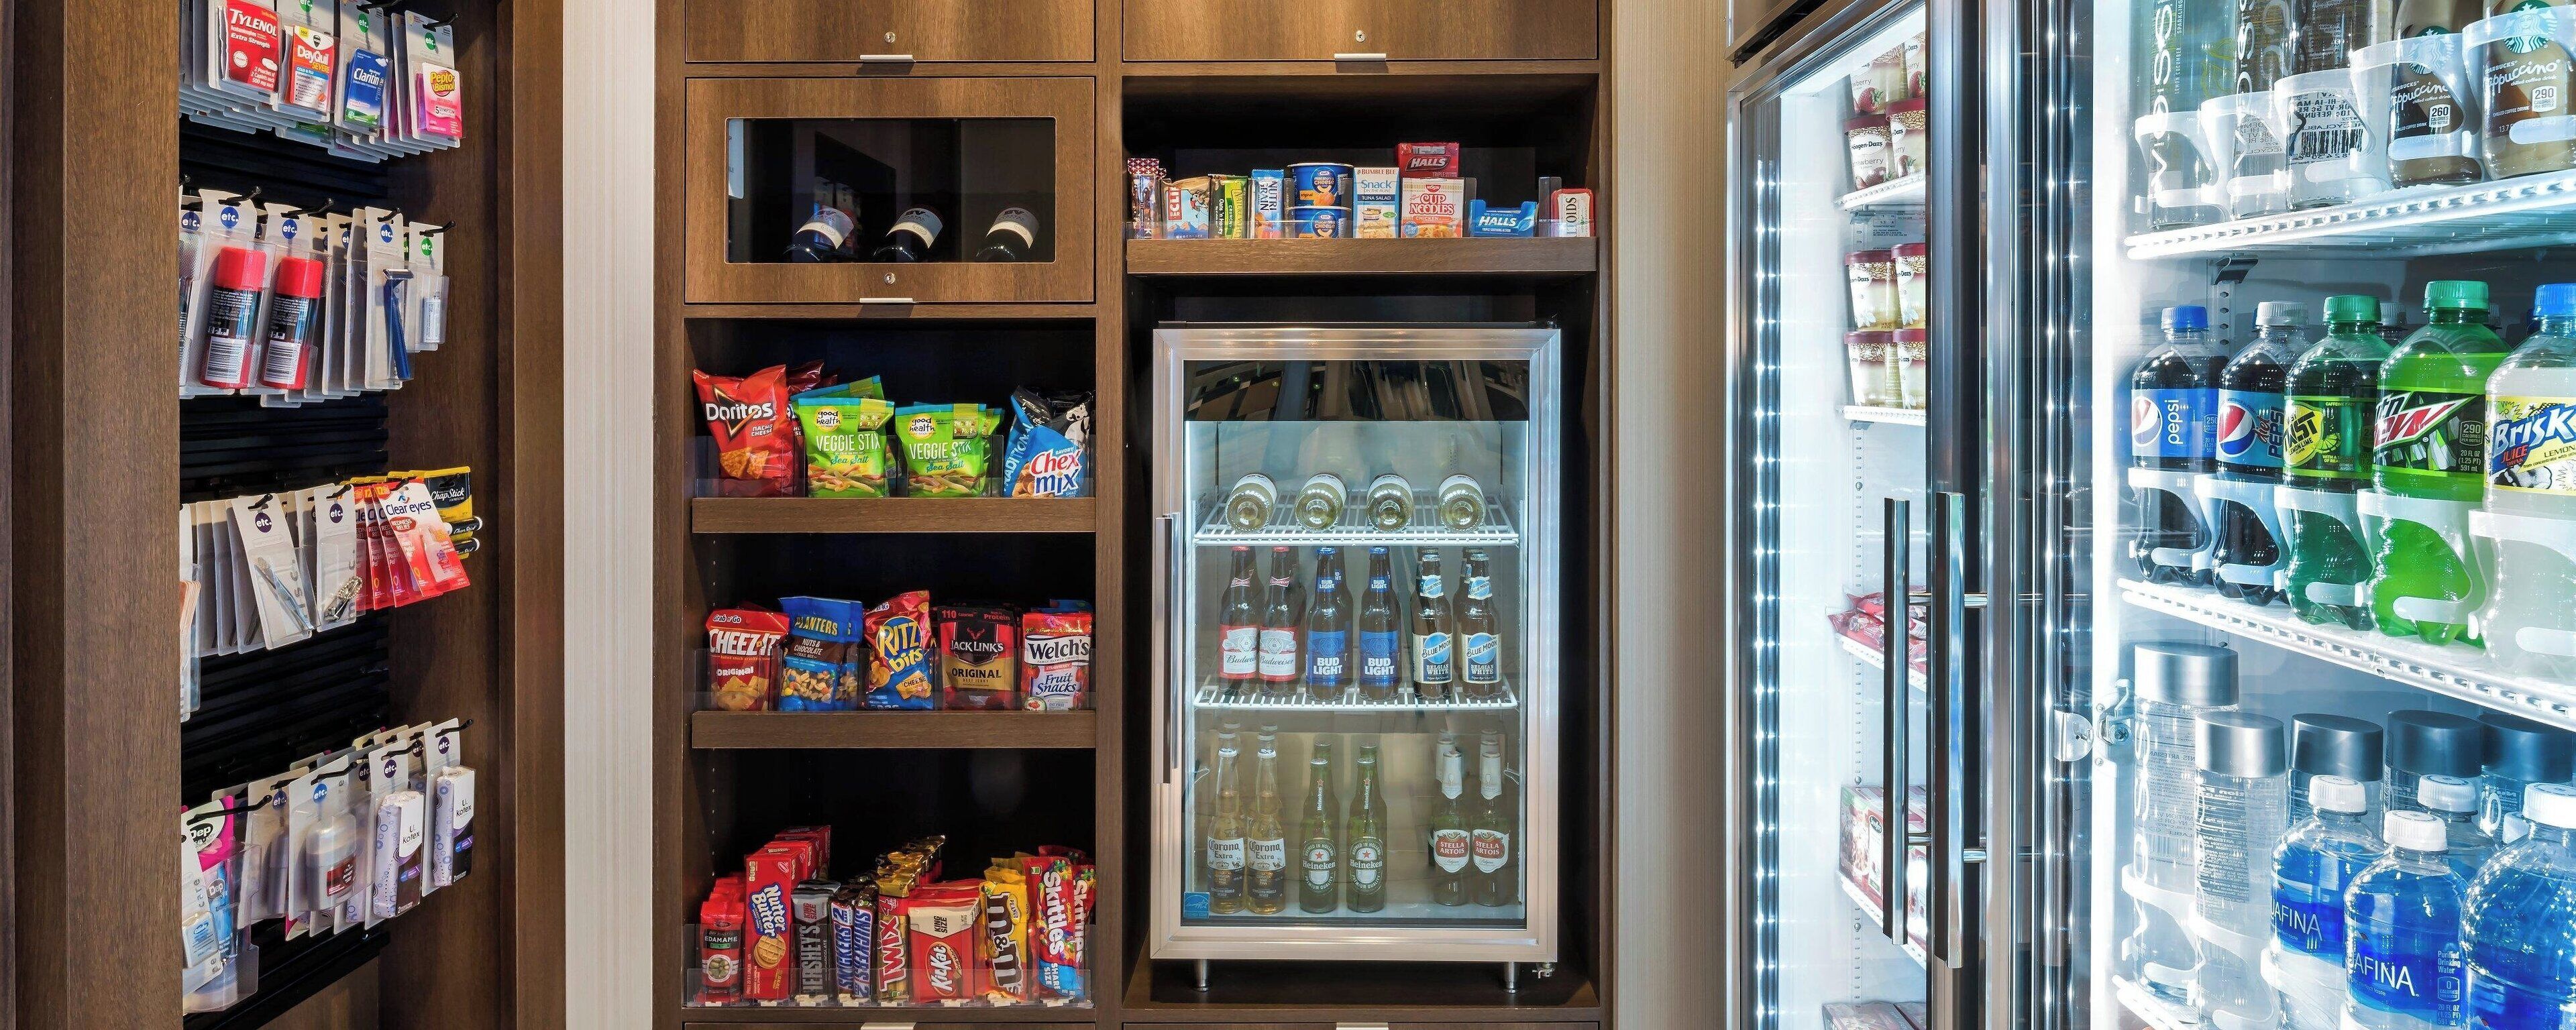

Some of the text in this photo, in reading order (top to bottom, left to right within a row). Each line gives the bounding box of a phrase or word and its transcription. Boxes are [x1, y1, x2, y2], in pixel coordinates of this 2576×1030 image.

[229, 8, 278, 37] TYLENOL
[358, 20, 369, 28] etc.
[230, 33, 270, 49] Extra Strength
[425, 38, 435, 46] etc.
[297, 45, 329, 65] DayQuil
[312, 62, 330, 73] SEVERE
[354, 68, 379, 86] Claritin
[431, 71, 455, 84] Pepto-
[433, 82, 455, 92] Bismol
[2391, 81, 2418, 93] STARBUCKS
[2535, 88, 2555, 99] 290
[2431, 107, 2449, 117] 260
[2499, 124, 2509, 133] 13.7
[1410, 158, 1446, 167] HALLS
[1361, 180, 1391, 189] Snack
[1268, 181, 1278, 211] NUTRI
[1420, 193, 1446, 205] CUP
[1409, 203, 1455, 215] NOODLES
[182, 219, 200, 227] etc.
[221, 213, 239, 222] etc.
[1479, 216, 1517, 227] HALLS
[282, 225, 297, 233] etc.
[381, 230, 393, 238] etc.
[706, 402, 773, 421] Doritos
[818, 410, 839, 419] good
[816, 416, 841, 425] health
[912, 417, 932, 426] good
[2164, 399, 2184, 445] pepsi
[751, 428, 773, 437] CHEESE
[753, 424, 773, 432] NACHO
[909, 423, 935, 432] health
[2267, 406, 2285, 459] PEPSI
[2463, 424, 2481, 434] 290
[816, 433, 881, 451] VEGGIE STIX
[2502, 444, 2530, 463] JUICE
[830, 455, 870, 466] Sea Salt
[1030, 451, 1081, 475] Chex
[2458, 457, 2481, 465] (1.25 PT)
[926, 461, 965, 473] Sea Salt
[1035, 469, 1079, 494] mix
[431, 488, 465, 501] ChapStick
[329, 510, 343, 518] etc.
[386, 504, 408, 516] Clear
[410, 501, 432, 515] eyes
[256, 518, 272, 528] etc.
[392, 518, 412, 527] REDNESS
[941, 610, 957, 619] 110
[794, 616, 838, 636] PLANTERS
[801, 638, 820, 648] NUTS &
[879, 622, 920, 659] RITZ
[951, 640, 973, 652] JACK
[794, 644, 823, 656] CHOCOLATE
[1027, 638, 1090, 661] Welch's
[1421, 638, 1452, 658] BLUE MOON
[1466, 639, 1498, 657] BLUE MOON
[888, 647, 924, 673] bits
[1317, 656, 1340, 667] BUD
[1368, 657, 1391, 667] BUD
[951, 668, 1002, 679] ORIGINAL
[1313, 665, 1342, 675] LIGHT
[1364, 666, 1395, 675] LIGHT
[903, 676, 926, 689] CHEESE
[1044, 673, 1073, 685] Fruit
[1035, 682, 1077, 695] Snacks
[438, 741, 450, 750] etc.
[384, 765, 397, 774] etc.
[313, 789, 327, 799] etc.
[273, 797, 287, 806] etc.
[1208, 839, 1239, 852] Corona
[1248, 840, 1281, 853] Corona
[1475, 841, 1500, 849] STELLA
[1214, 851, 1233, 859] Extra
[1256, 852, 1275, 860] Extra
[1303, 860, 1336, 869] Heineken
[1350, 859, 1383, 869] Heineken
[209, 882, 223, 896] Dep
[763, 884, 786, 931] Nutter
[1009, 899, 1018, 919] PEANUT
[751, 891, 775, 937] Butter
[1043, 871, 1068, 956] Skittles
[933, 915, 941, 933] KING
[853, 909, 872, 982] SNICKERS
[834, 921, 854, 990] SNICKERS
[878, 915, 906, 991] TWIX
[2438, 950, 2459, 959] Purified
[2437, 958, 2461, 968] Drinking
[1044, 966, 1052, 986] SIZE
[1051, 962, 1061, 990] SHARE
[2447, 980, 2452, 989] 0
